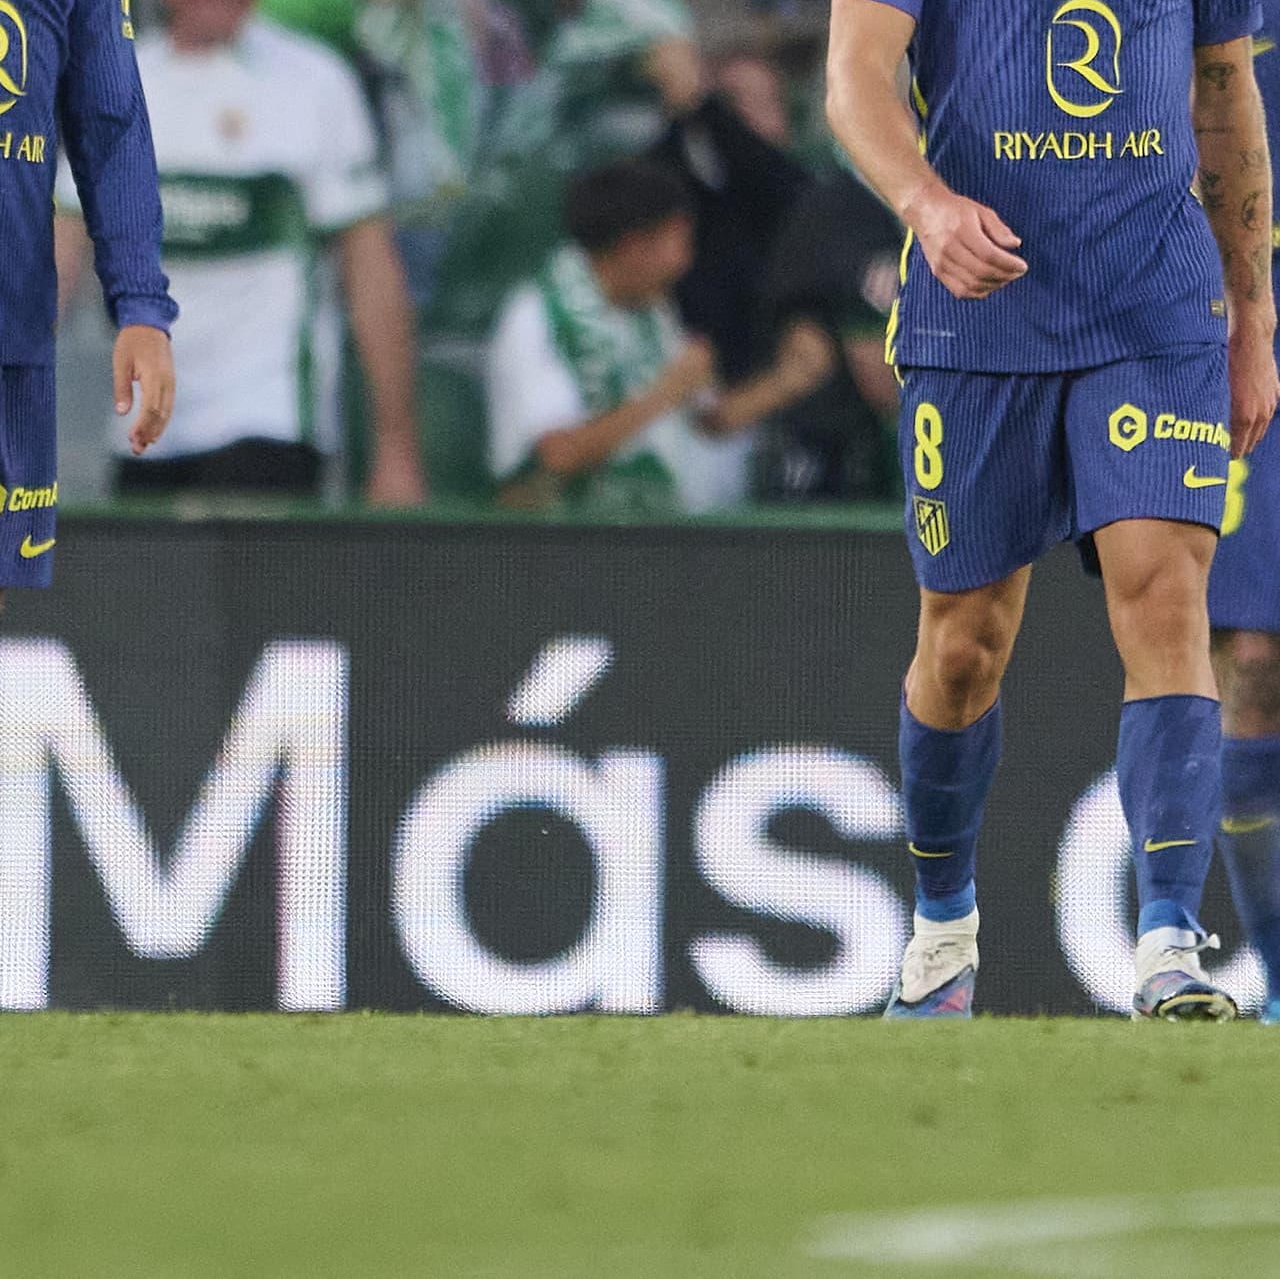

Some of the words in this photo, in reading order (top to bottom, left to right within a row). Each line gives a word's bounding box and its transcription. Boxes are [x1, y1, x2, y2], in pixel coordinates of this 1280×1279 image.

[17, 134, 46, 164] AIR
[994, 130, 1113, 161] RIYADH
[1120, 128, 1165, 159] AIR
[914, 402, 944, 490] 8
